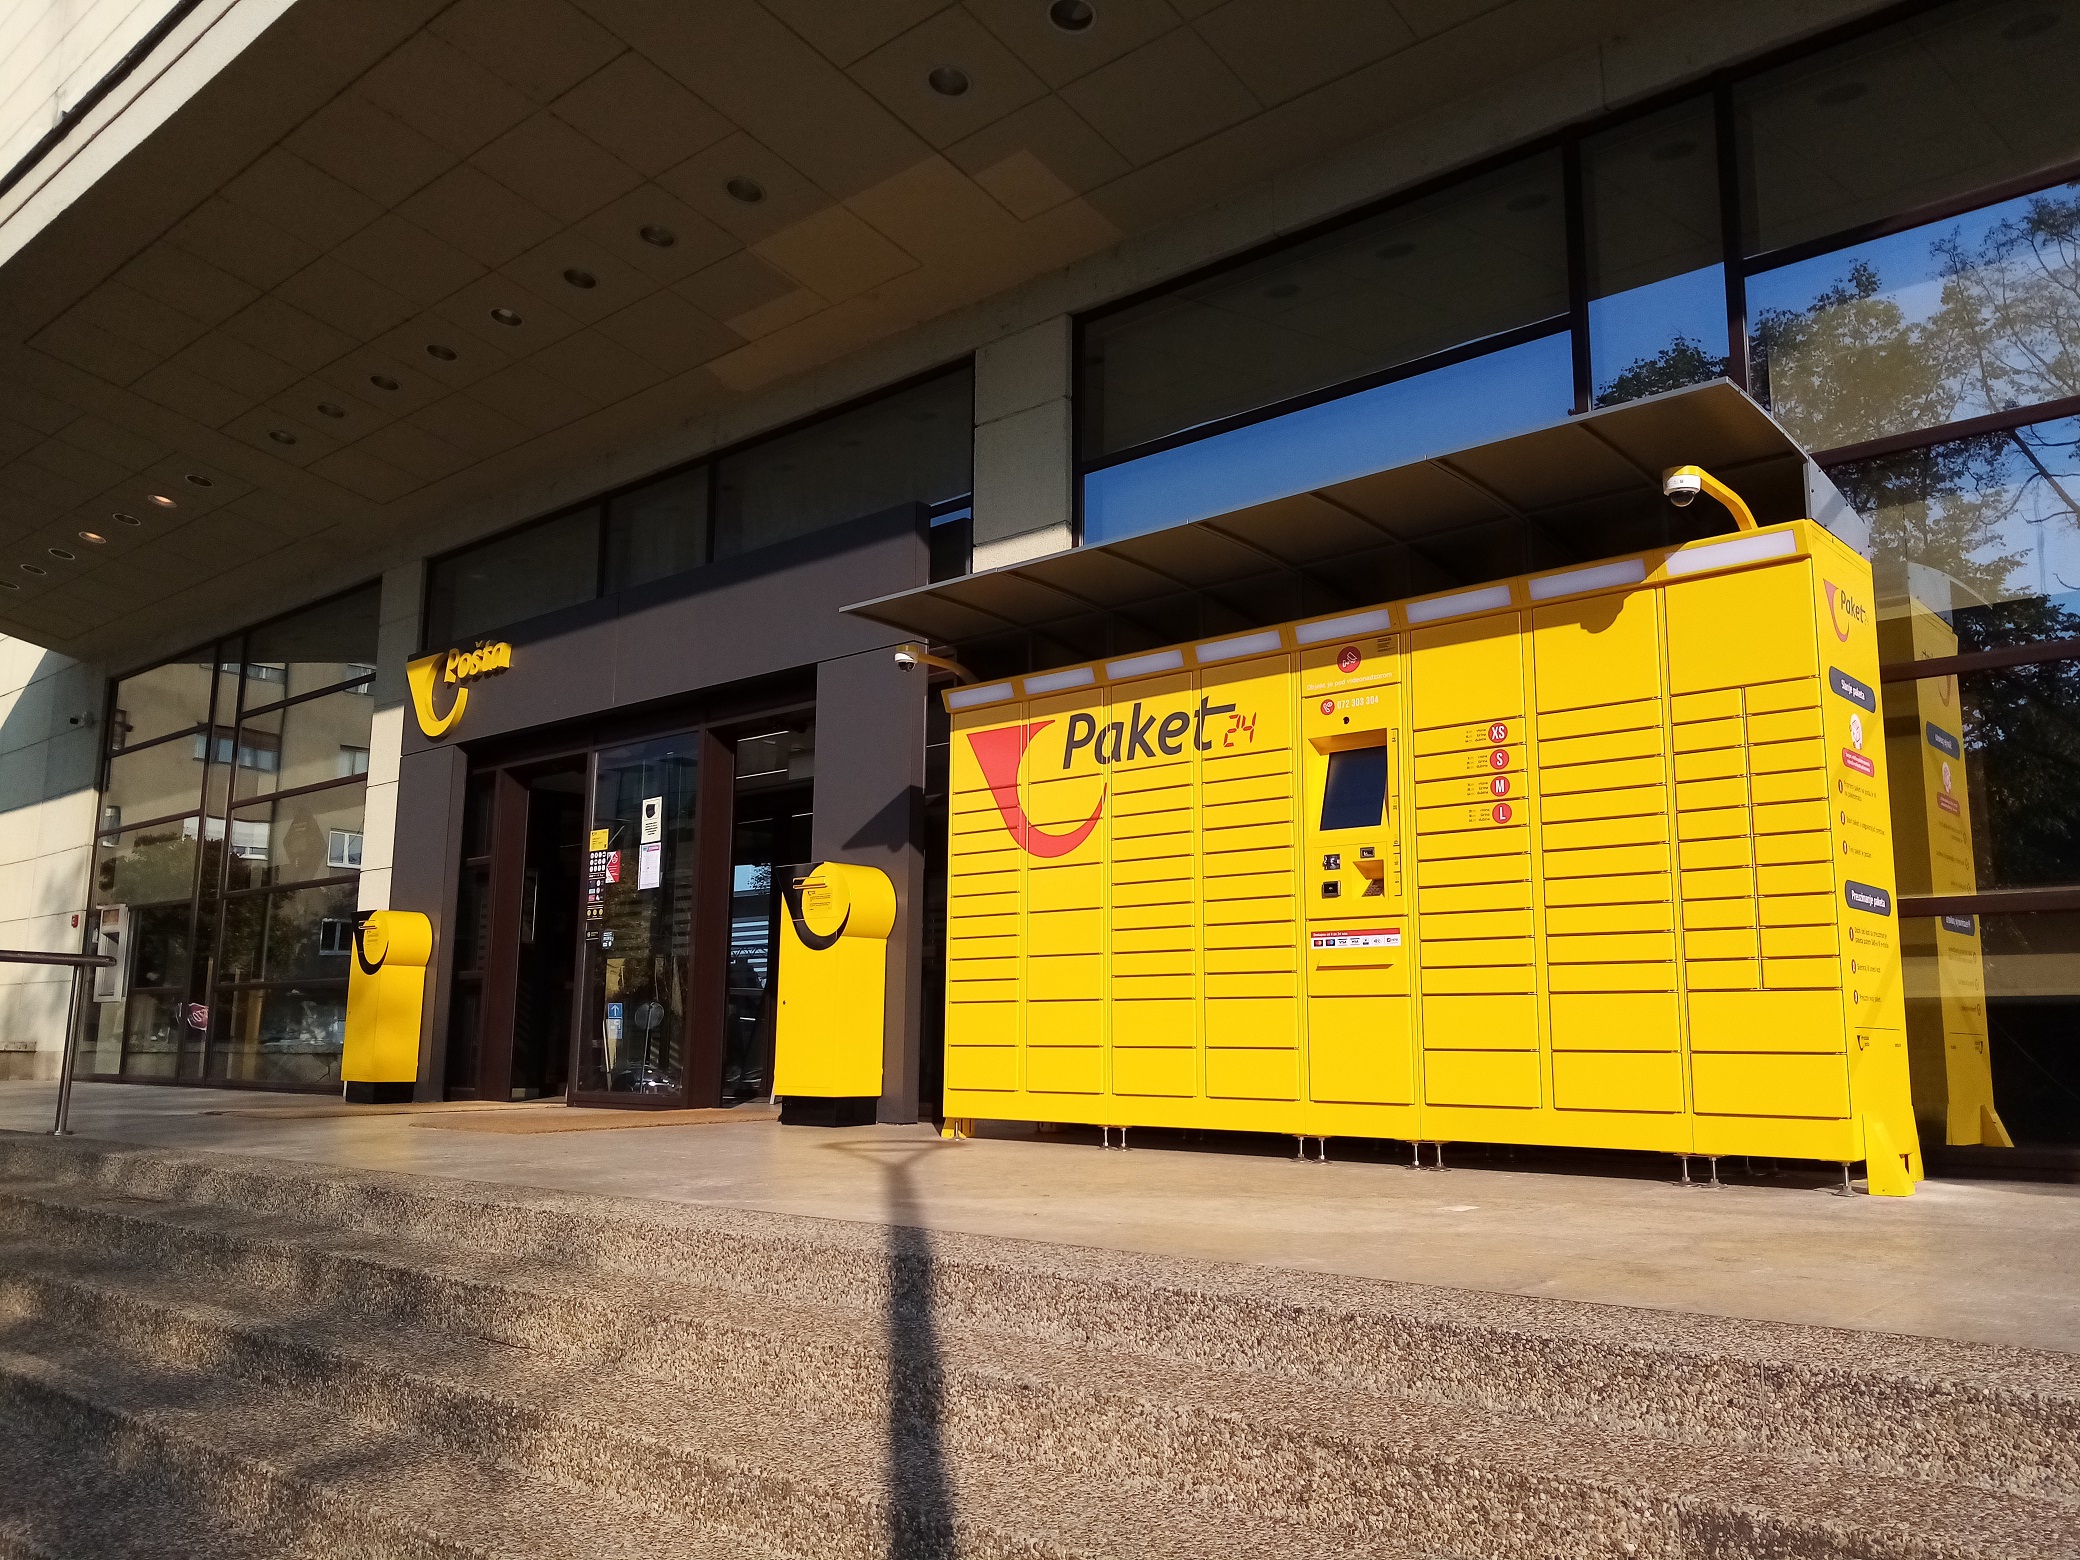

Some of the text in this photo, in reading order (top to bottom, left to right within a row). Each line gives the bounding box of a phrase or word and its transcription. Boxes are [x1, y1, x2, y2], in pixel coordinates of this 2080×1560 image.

[1840, 589, 1865, 623] Paket
[1334, 679, 1346, 687] pod
[1337, 699, 1350, 709] 072
[1351, 697, 1365, 707] 303
[1063, 695, 1257, 769] Paket 24
[1491, 725, 1505, 740] XS
[1496, 752, 1503, 766] S
[1495, 779, 1505, 793] M
[1499, 806, 1506, 820] L
